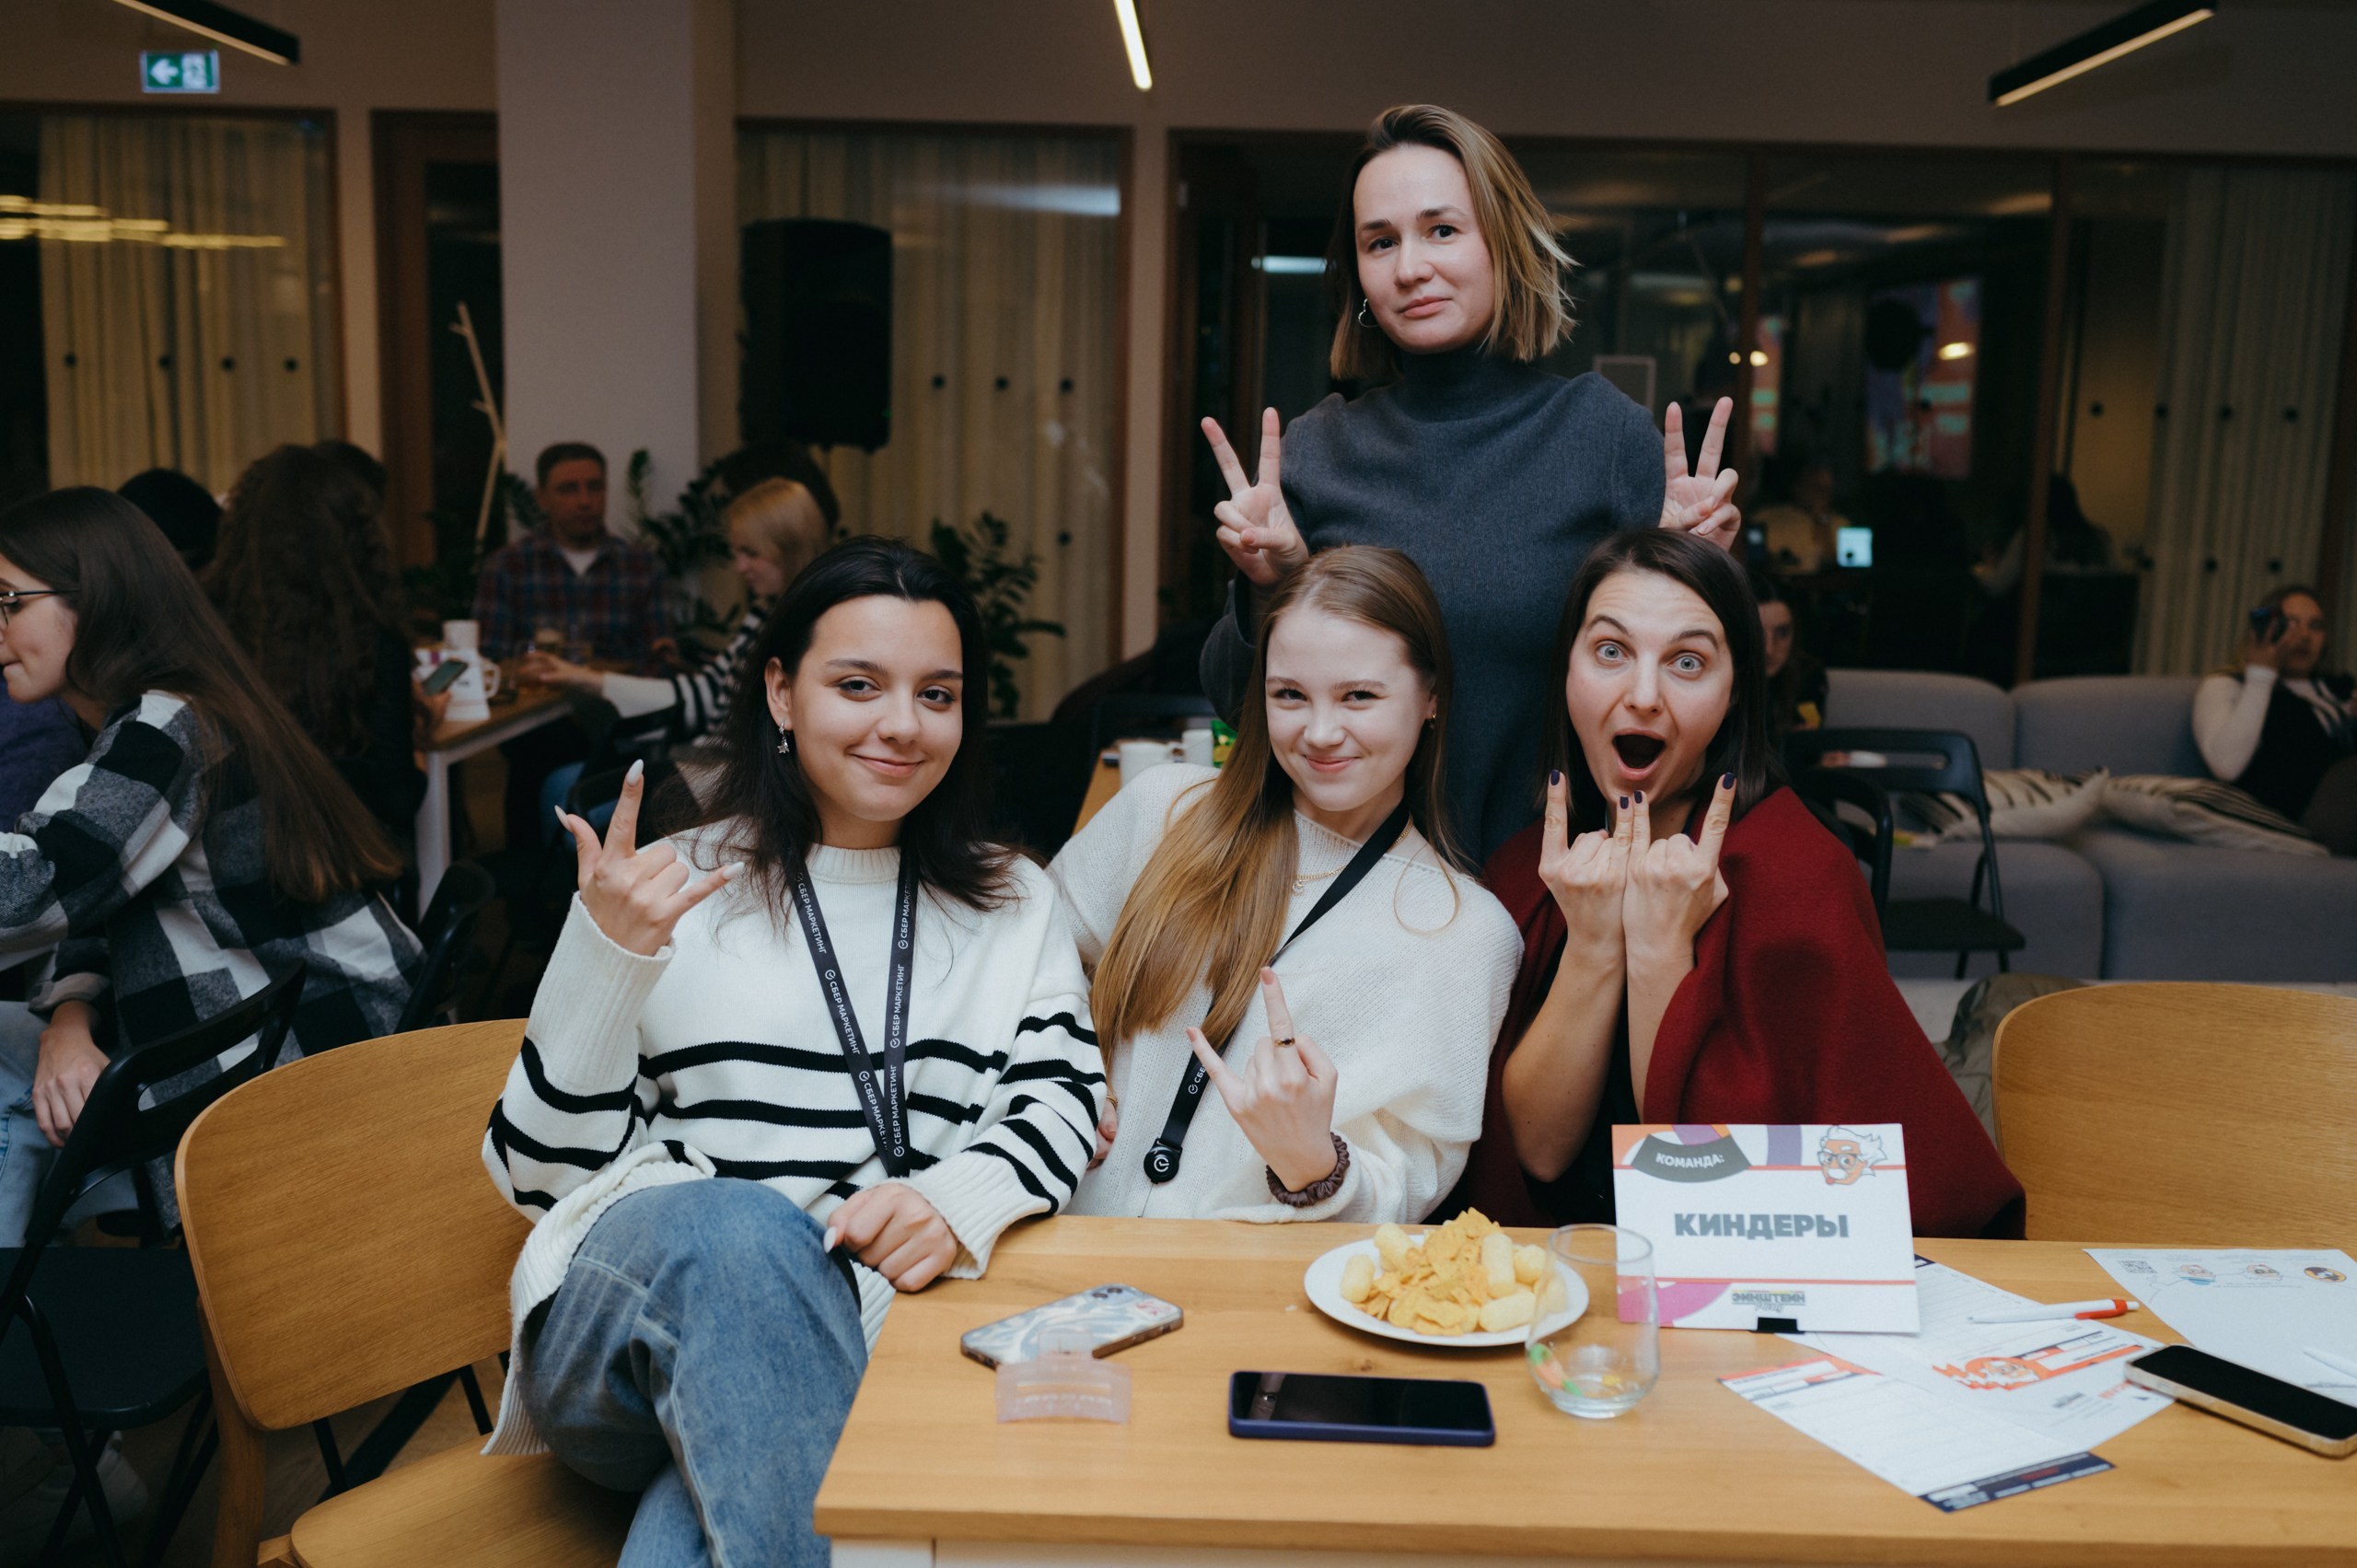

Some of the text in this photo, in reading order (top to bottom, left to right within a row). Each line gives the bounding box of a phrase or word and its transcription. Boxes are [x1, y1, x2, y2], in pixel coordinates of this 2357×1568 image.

[798, 883, 827, 954] СБЕР МАРКЕТИНГ
[900, 918, 909, 938] СБЕР
[892, 964, 904, 1037] СБЕР МАРКЕТИНГ
[830, 981, 861, 1055] СБЕР МАРКЕТИНГ
[1194, 1064, 1206, 1084] СБЕ
[864, 1083, 877, 1105] СБЕР
[889, 1064, 902, 1144] СБЕР МАРКЕТИНГ
[1656, 1153, 1724, 1168] КОМАНДА:
[1674, 1213, 1850, 1240] КИНДЕРЫ
